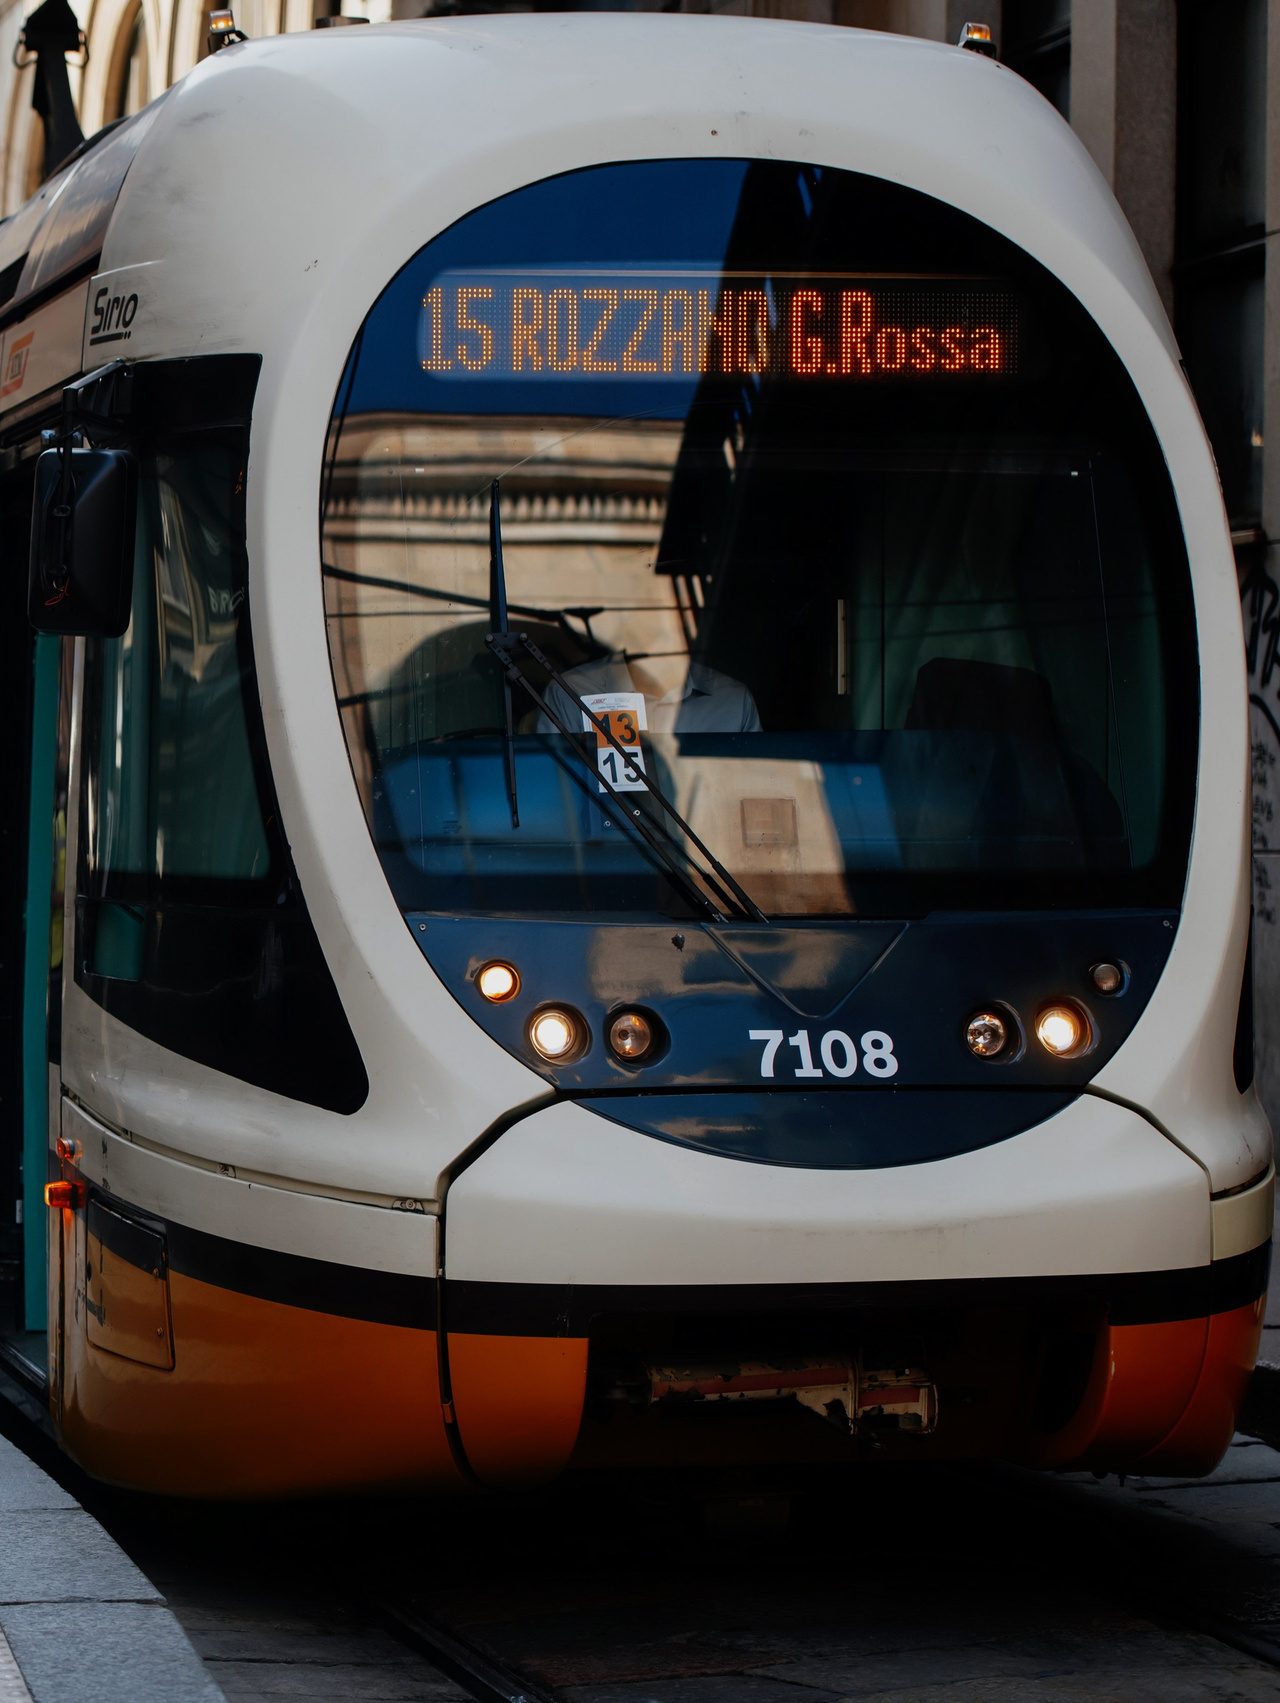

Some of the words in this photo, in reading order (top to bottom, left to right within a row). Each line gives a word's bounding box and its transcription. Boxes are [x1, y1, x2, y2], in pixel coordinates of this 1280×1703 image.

[421, 287, 494, 372] 15
[511, 287, 769, 373] ROZZANO
[790, 289, 1001, 374] G.Rossa
[599, 712, 637, 745] 13
[602, 751, 641, 784] 15
[748, 1029, 899, 1079] 7108
